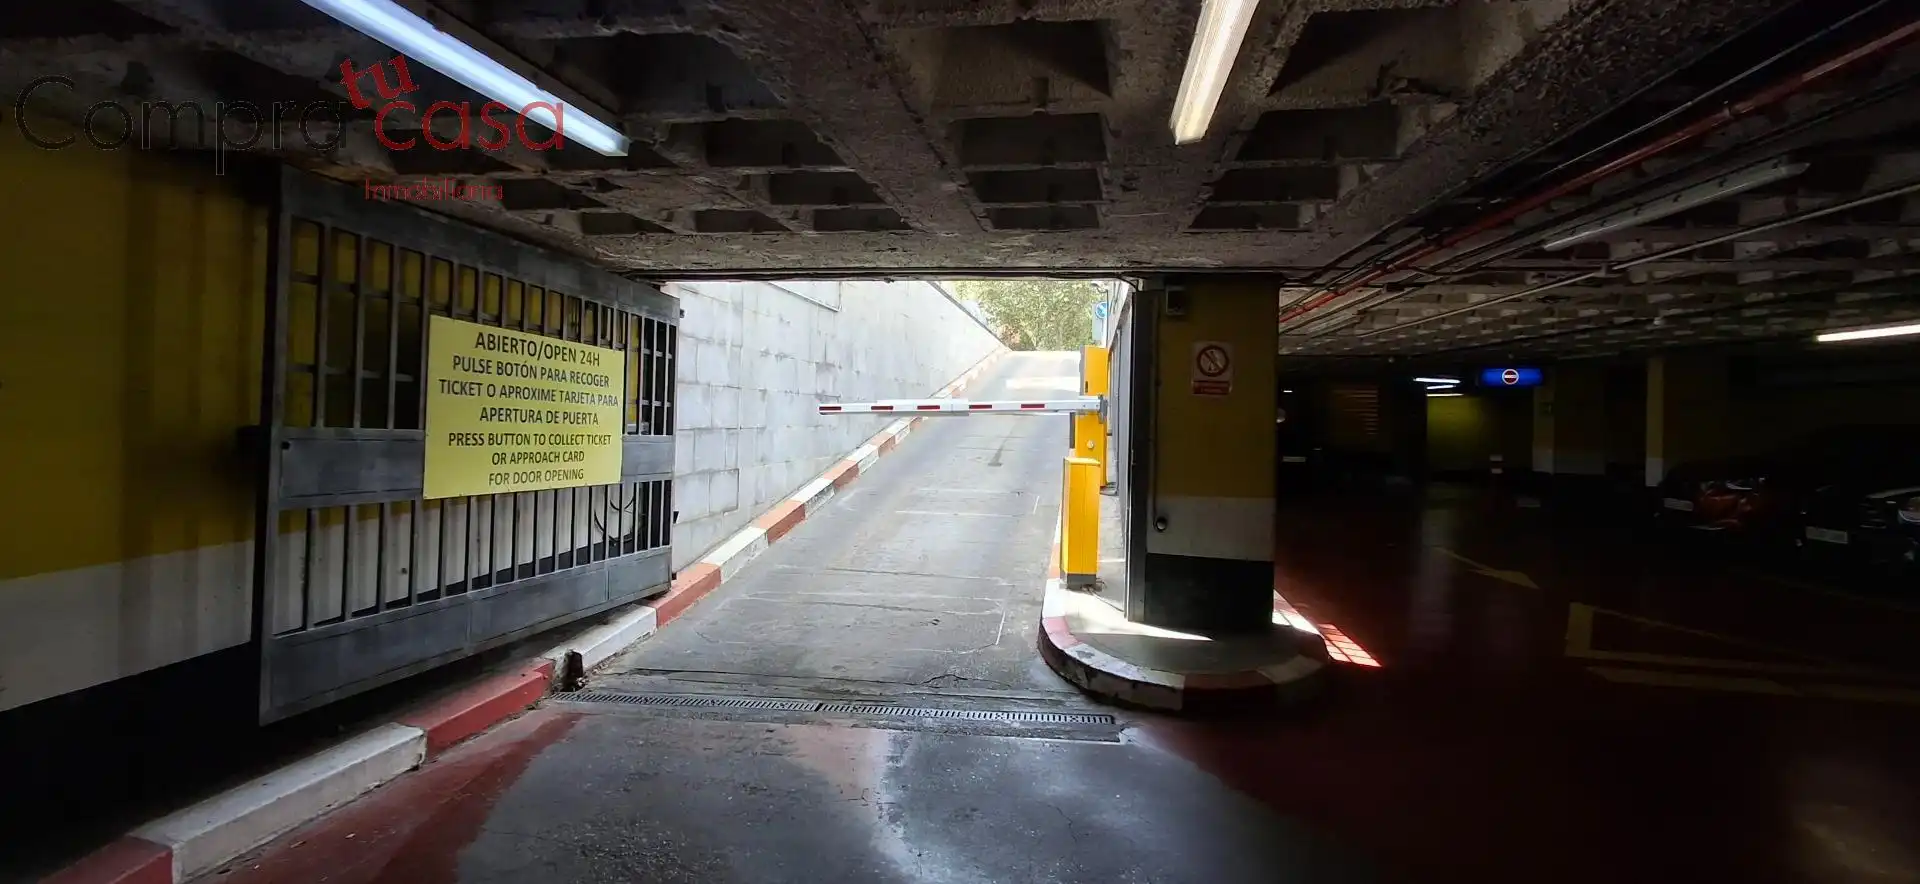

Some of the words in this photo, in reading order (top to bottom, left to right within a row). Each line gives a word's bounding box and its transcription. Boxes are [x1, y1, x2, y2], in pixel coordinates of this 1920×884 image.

[475, 332, 576, 363] ABIERTO/OPEN
[580, 350, 600, 367] 24H
[453, 356, 492, 375] PULSE
[497, 360, 537, 379] BOTÓN
[541, 367, 567, 382] PARA
[570, 371, 609, 387] RECOGER
[439, 379, 483, 396] TICKET
[487, 384, 495, 397] O
[500, 385, 556, 401] APROXIME
[559, 390, 595, 405] TARJETA
[598, 394, 618, 407] PARA
[480, 407, 542, 423] APERTURA
[546, 411, 559, 424] DE
[563, 412, 598, 425] PUERTA
[449, 433, 484, 446] PRESS
[488, 434, 530, 445] BUTTON
[534, 434, 545, 445] TO
[549, 434, 584, 445] COLLECT
[587, 435, 611, 445] TICKET
[492, 453, 506, 465] OR
[510, 451, 560, 464] APPROACH
[563, 451, 584, 462] CARD
[489, 473, 510, 486] FOR
[513, 471, 541, 484] DOOR
[545, 469, 583, 482] OPENING
